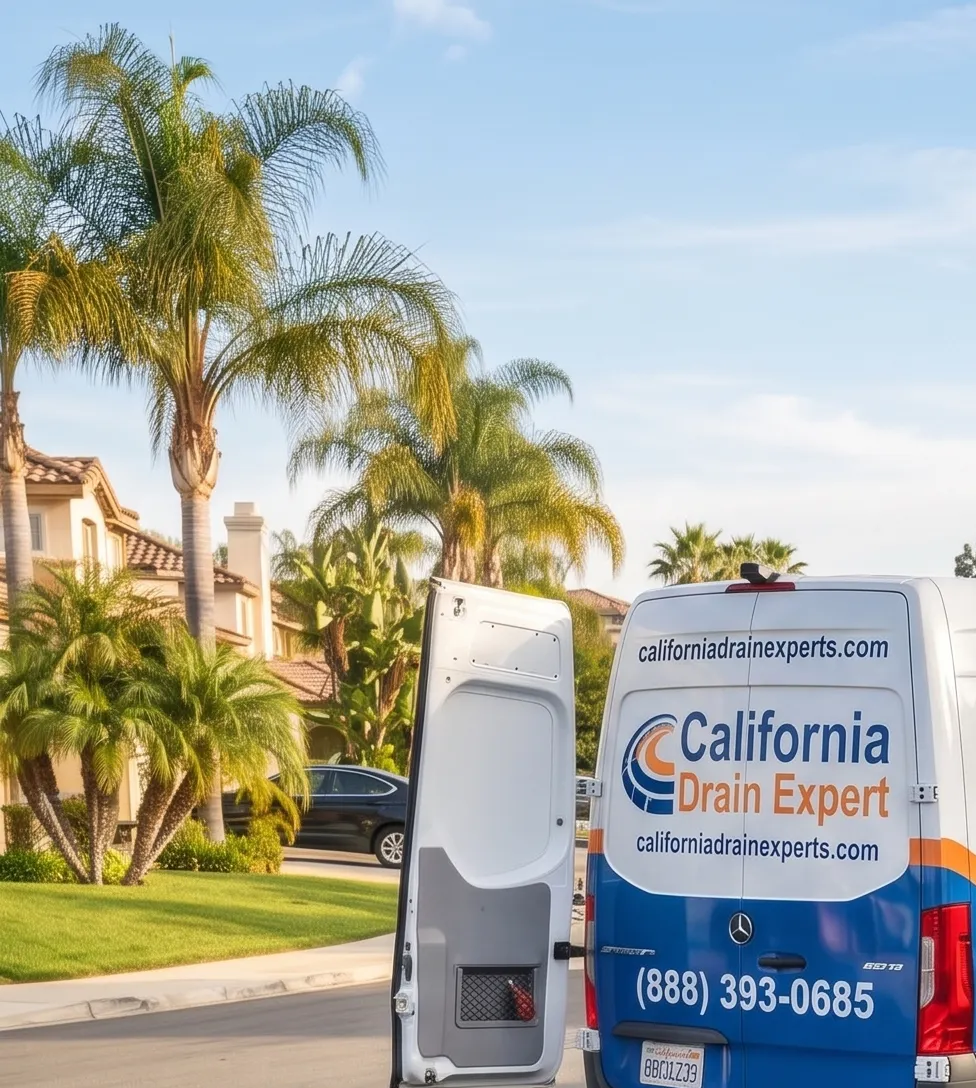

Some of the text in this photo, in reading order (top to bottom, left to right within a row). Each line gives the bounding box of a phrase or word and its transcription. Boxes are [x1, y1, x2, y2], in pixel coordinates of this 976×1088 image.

[638, 635, 889, 663] californiadrainexperts.com
[681, 709, 890, 764] California
[678, 772, 890, 826] Drain Expert
[636, 831, 879, 863] californiadrainexperts.com
[636, 967, 874, 1019] (888) 393-0685
